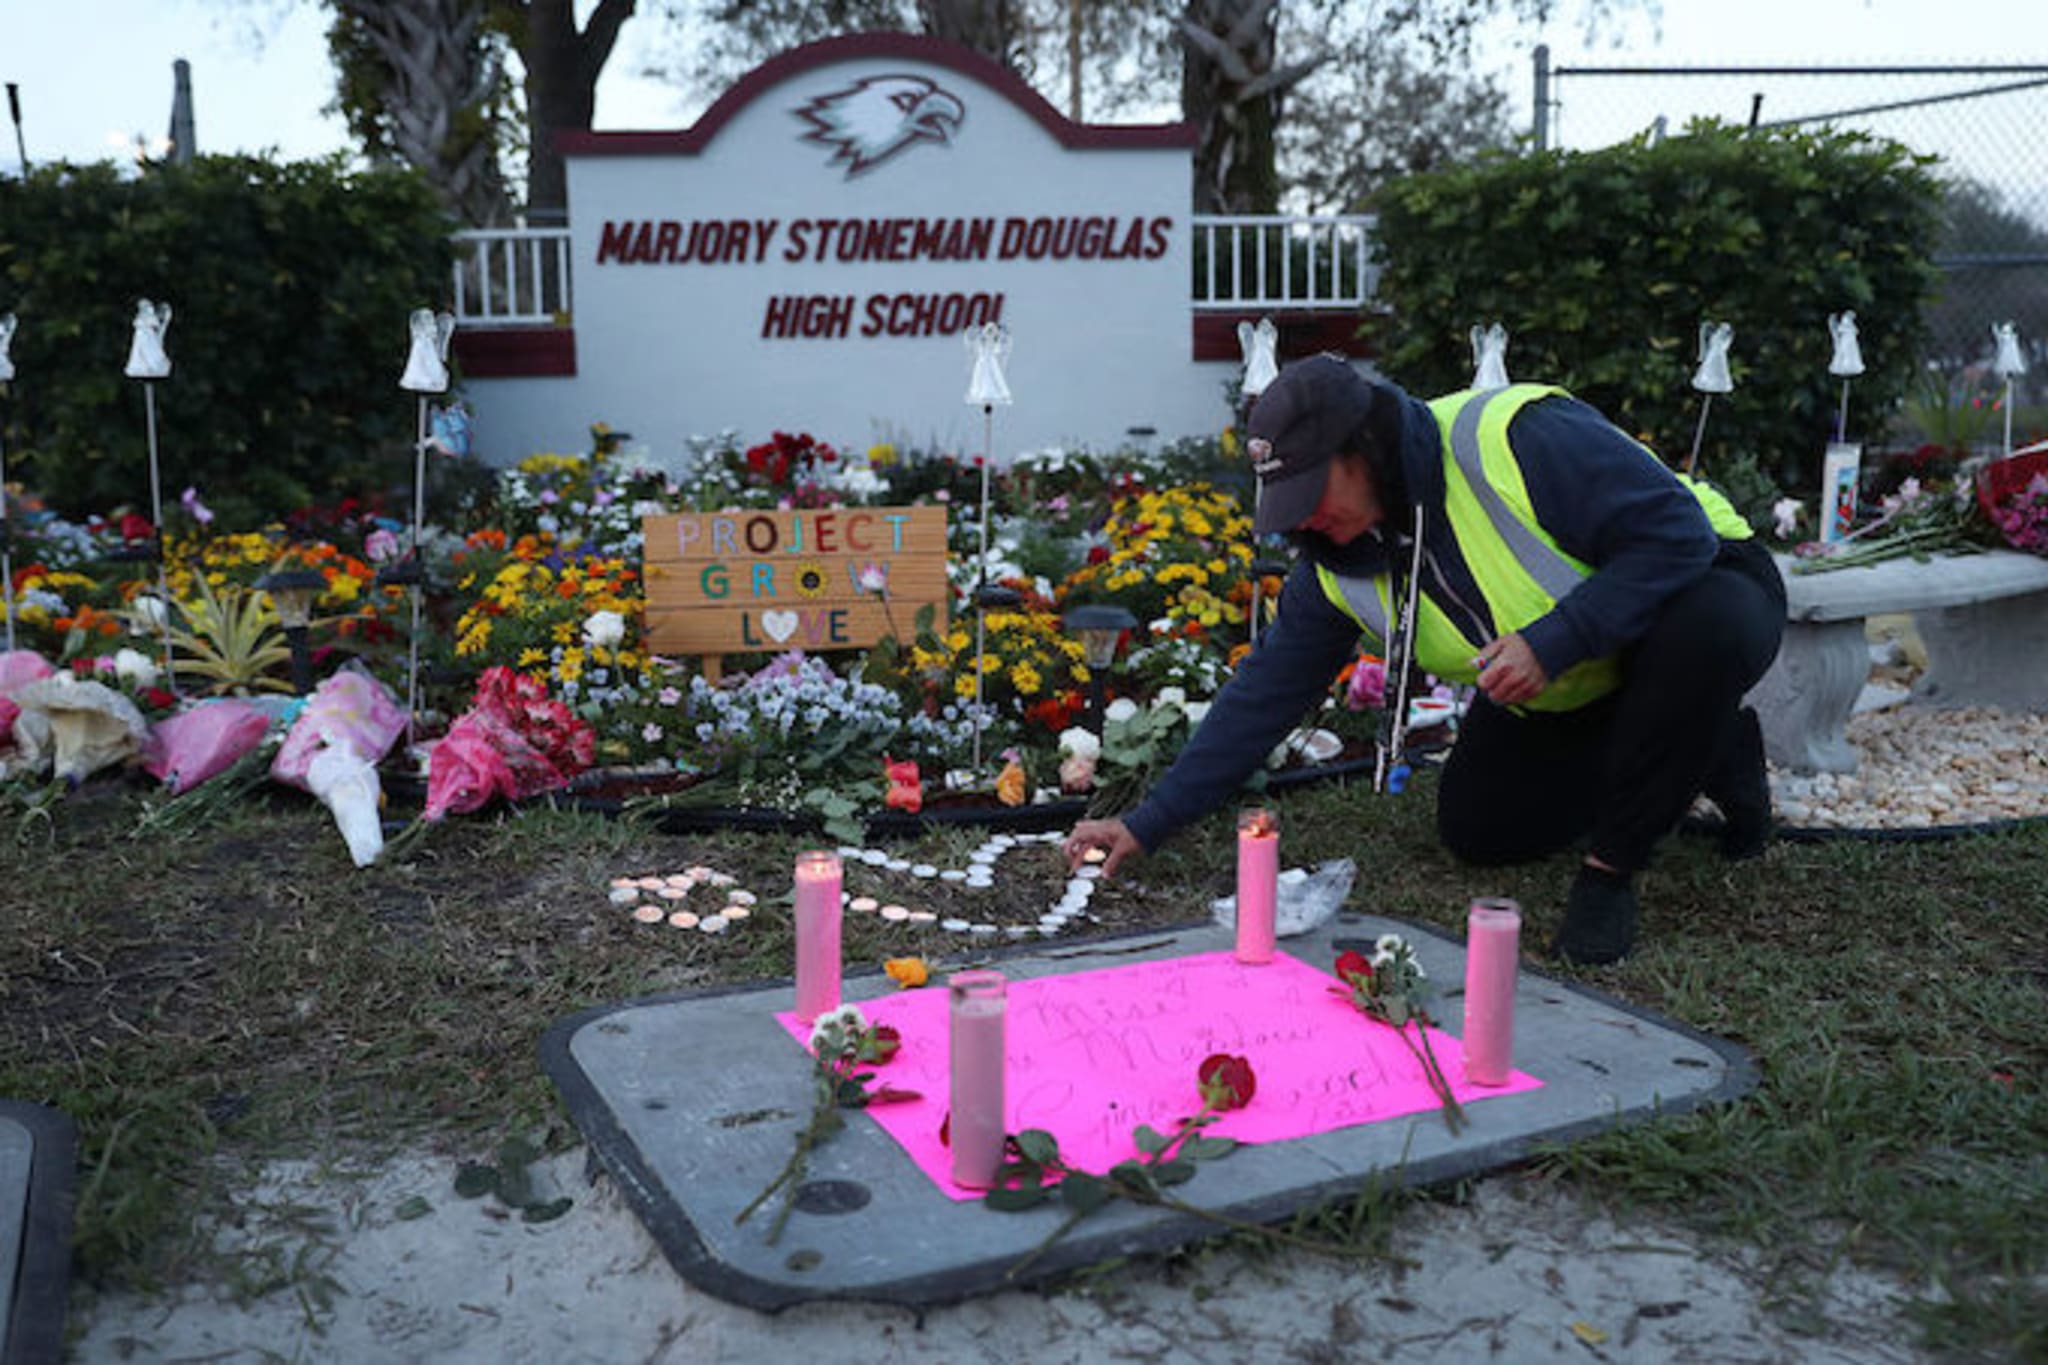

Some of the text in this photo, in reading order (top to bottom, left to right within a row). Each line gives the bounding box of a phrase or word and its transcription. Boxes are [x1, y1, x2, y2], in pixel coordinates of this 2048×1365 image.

[597, 216, 1173, 265] MARJORY STONEMAN DOUGLAS
[761, 295, 853, 339] HIGH
[677, 514, 911, 554] PROJECT
